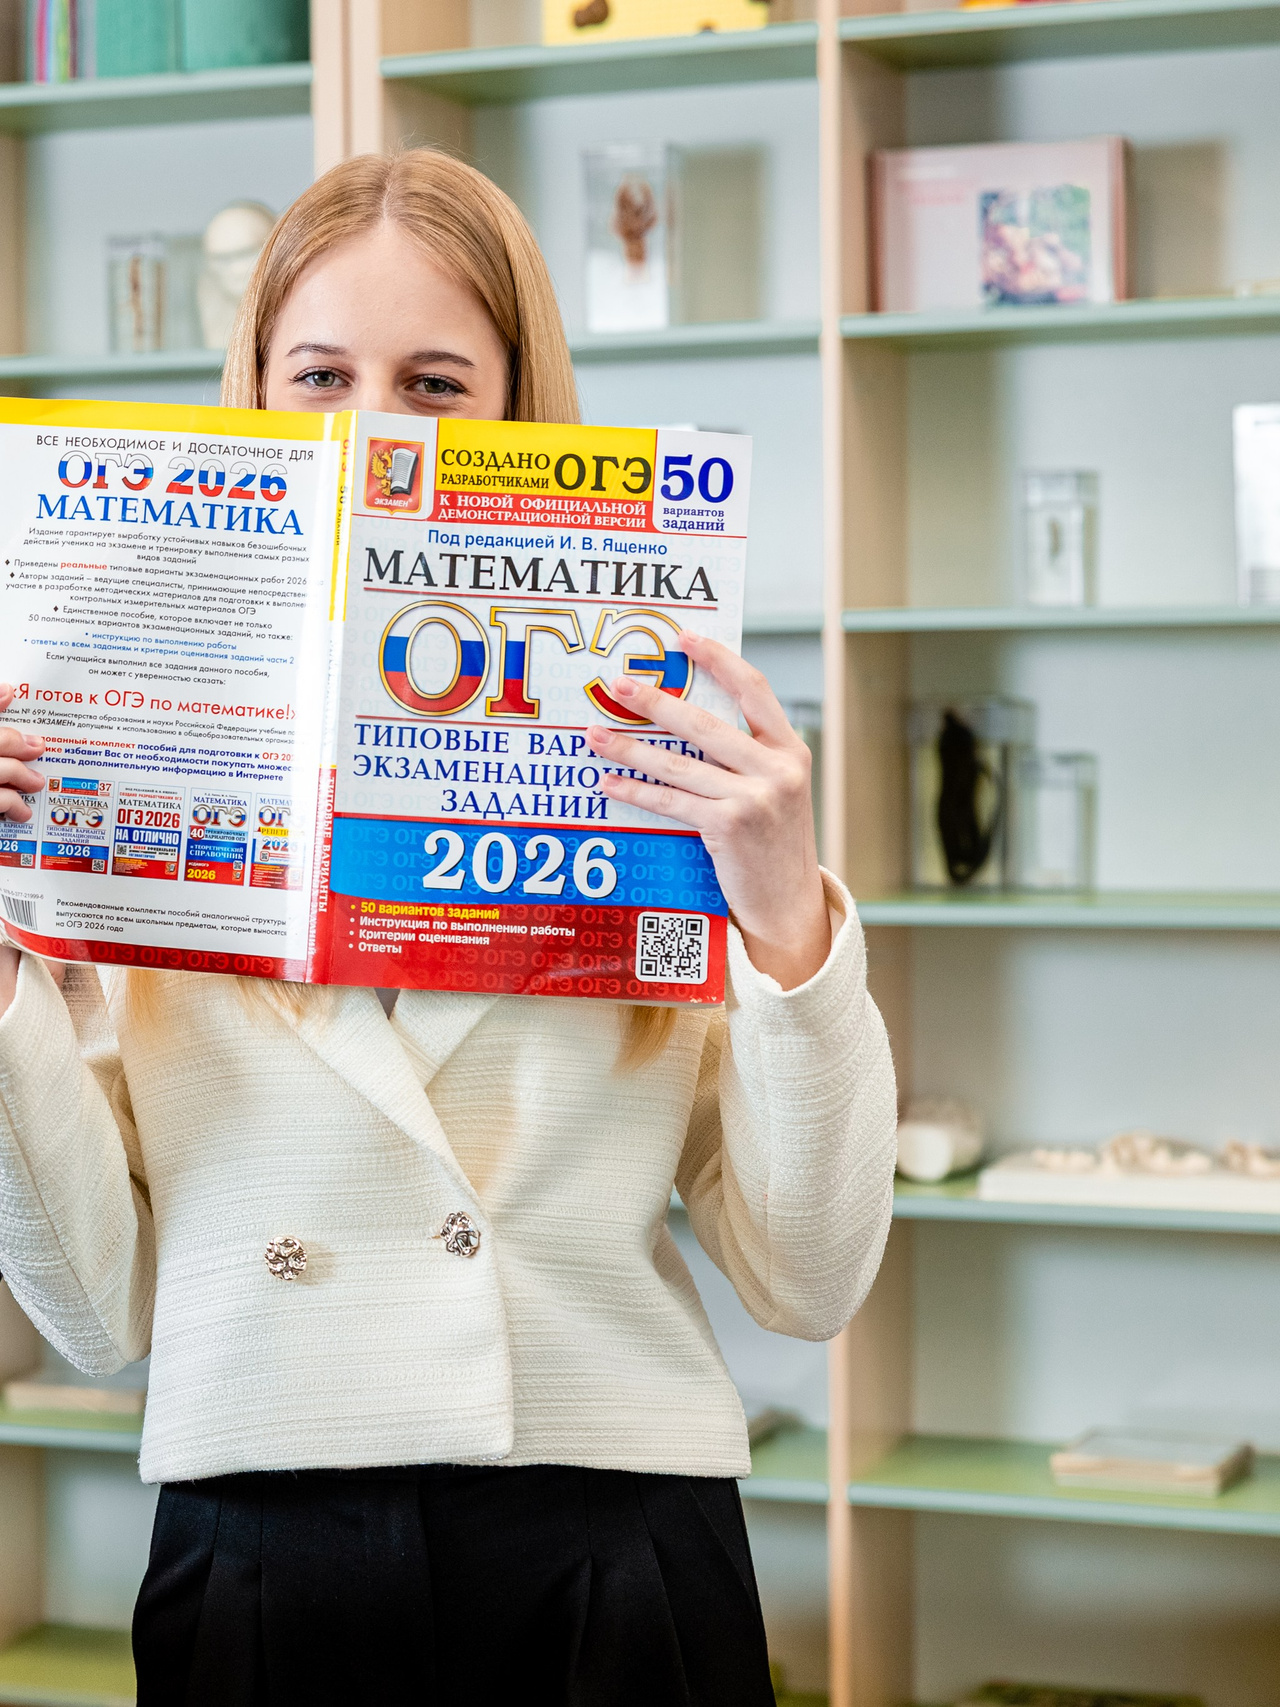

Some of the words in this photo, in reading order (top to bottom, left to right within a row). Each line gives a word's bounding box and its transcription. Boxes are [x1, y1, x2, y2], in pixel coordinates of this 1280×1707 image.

[36, 434, 58, 446] ВСЕ
[65, 436, 165, 450] НЕОБХОДИМОЕ
[172, 441, 181, 451] И
[187, 442, 282, 459] ДОСТАТОЧНОЕ
[288, 449, 313, 461] ДЛЯ
[441, 448, 550, 471] СОЗДАНО
[58, 450, 154, 491] ОГЭ
[166, 456, 288, 502] 2026
[441, 473, 550, 489] РАЗРАБОТЧИКАМИ
[554, 452, 652, 494] ОГЭ
[659, 454, 735, 503] 50
[36, 494, 303, 536] МАТЕМАТИКА
[439, 494, 449, 511] К
[456, 494, 513, 513] НОВОЙ
[519, 497, 645, 515] ОФИЦИАЛЬНОЙ
[663, 505, 725, 518] вариантов
[437, 508, 590, 529] ДЕМОНСТРАЦИОННОЙ
[594, 514, 645, 527] ВЕРСИИ
[662, 518, 725, 532] заданий
[28, 527, 63, 535] Издание
[65, 530, 115, 538] гарантирует
[117, 532, 161, 542] выработку
[163, 535, 209, 545] устойчивых
[211, 540, 245, 548] навыков
[247, 540, 306, 551] безошибочных
[428, 529, 459, 546] Под
[464, 534, 554, 549] редакцией
[560, 535, 575, 549] И.
[581, 536, 596, 550] В.
[602, 537, 667, 555] Ященко
[363, 546, 718, 602] МАТЕМАТИКА
[91, 633, 140, 642] инструкцию
[154, 638, 204, 647] выполнению
[206, 640, 236, 649] работы
[378, 600, 694, 725] ОГЭ
[35, 689, 83, 703] готов
[89, 693, 98, 704] к
[104, 689, 144, 708] ОГЭ
[150, 698, 172, 710] по
[353, 723, 510, 754] ТИПОВЫЕ
[99, 783, 112, 792] 37
[48, 796, 109, 808] МАТЕМАТИКА
[118, 798, 182, 810] МАТЕМАТИКА
[193, 796, 247, 807] МАТЕМАТИКА
[323, 776, 335, 839] ТИПОВЫЕ
[440, 788, 610, 820] ЗАДАНИЙ
[50, 805, 104, 828] ОГЭ
[117, 808, 143, 826] ОГЭ
[144, 811, 181, 829] 2026
[192, 804, 247, 828] ОГЭ
[115, 828, 129, 841] НА
[132, 829, 180, 845] ОТЛИЧНО
[189, 828, 205, 838] 40
[57, 844, 91, 857] 2026
[189, 849, 244, 860] СПРАВОЧНИК
[186, 868, 216, 880] 2026
[422, 829, 618, 899] 2026
[318, 844, 331, 913] ВАРИАНТЫ
[56, 898, 124, 911] Рекомендованные
[125, 906, 166, 914] комплекты
[167, 909, 199, 917] пособий
[201, 913, 249, 921] аналогичной
[251, 917, 285, 925] структуры
[360, 901, 375, 913] 50
[378, 904, 444, 916] вариантов
[447, 907, 499, 919] заданий
[66, 919, 82, 928] ОГЭ
[84, 921, 104, 930] 2026
[359, 914, 429, 930] Инструкция
[432, 921, 447, 929] по
[450, 917, 527, 934] выполнению
[530, 925, 575, 936] работы
[358, 928, 415, 942] Критерии
[418, 933, 489, 945] оценивания
[358, 940, 401, 953] Ответы
